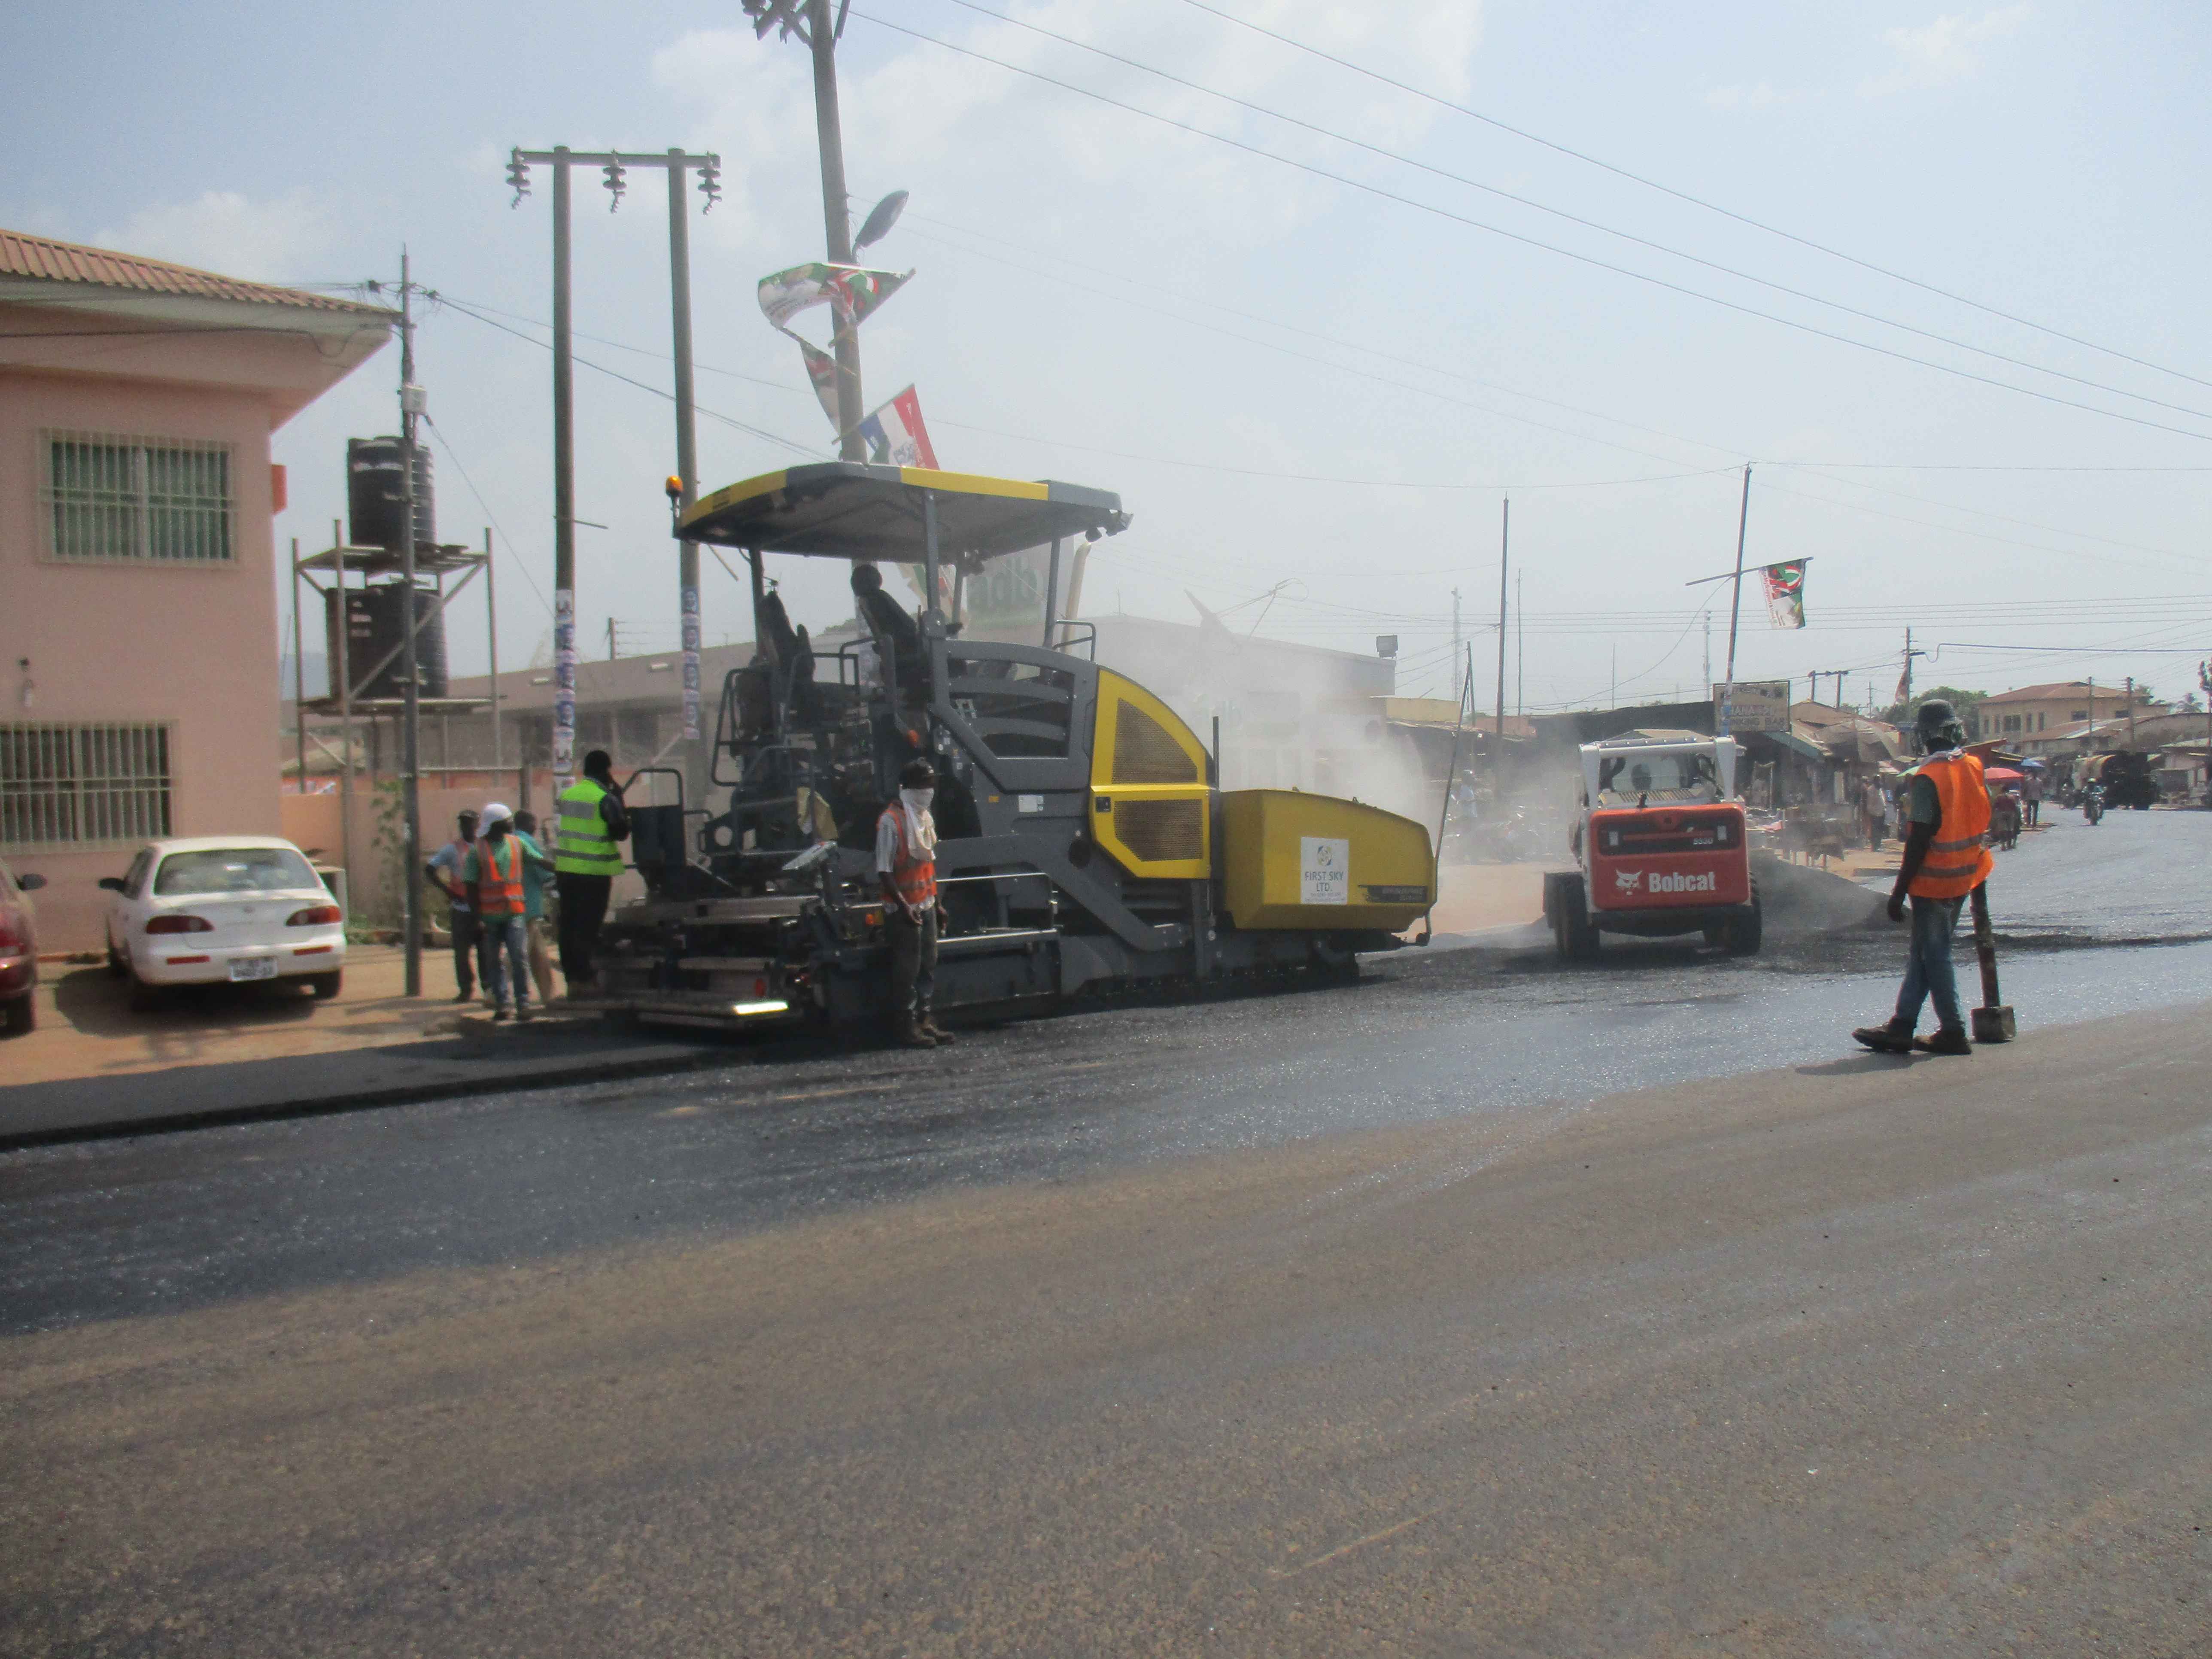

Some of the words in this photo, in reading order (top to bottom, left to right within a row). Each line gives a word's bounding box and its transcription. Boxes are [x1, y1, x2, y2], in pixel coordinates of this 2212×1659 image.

[1305, 871, 1326, 881] FIRST
[1329, 871, 1343, 881] SKY
[1316, 882, 1333, 891] LTD.
[1649, 872, 1715, 892] Bobcat
